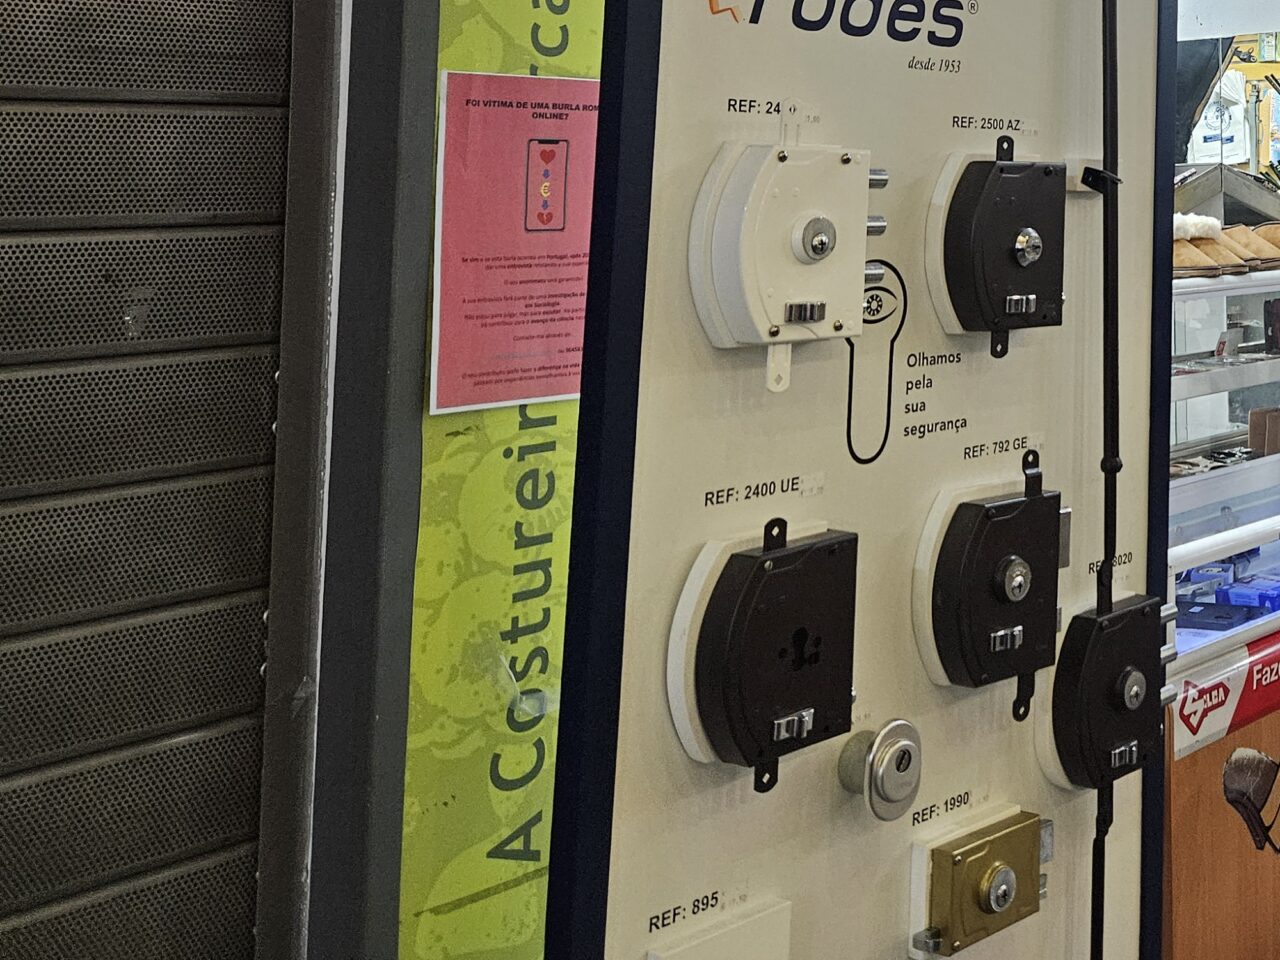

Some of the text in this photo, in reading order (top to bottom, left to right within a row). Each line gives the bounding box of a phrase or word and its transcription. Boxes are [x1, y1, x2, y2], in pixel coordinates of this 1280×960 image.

[908, 56, 961, 74] desde 1953
[465, 99, 480, 107] FOI
[516, 101, 528, 109] DE
[530, 102, 550, 110] UMA
[551, 102, 580, 111] BURLA
[727, 98, 761, 114] REF:
[531, 111, 569, 120] ONLINE?
[952, 115, 1021, 131] REF: 2500 AZ
[906, 350, 962, 368] Olhamos
[905, 375, 933, 395] pela
[904, 400, 926, 414] sua
[903, 416, 968, 439] segurança
[963, 441, 989, 460] REF:
[991, 440, 1011, 457] 792
[1013, 436, 1028, 452] GE
[704, 486, 740, 507] REF:
[744, 480, 777, 501] 2400
[780, 476, 800, 493] UE
[912, 790, 970, 827] REF: 1990
[486, 810, 543, 862] A
[648, 890, 720, 934] REF: 895
